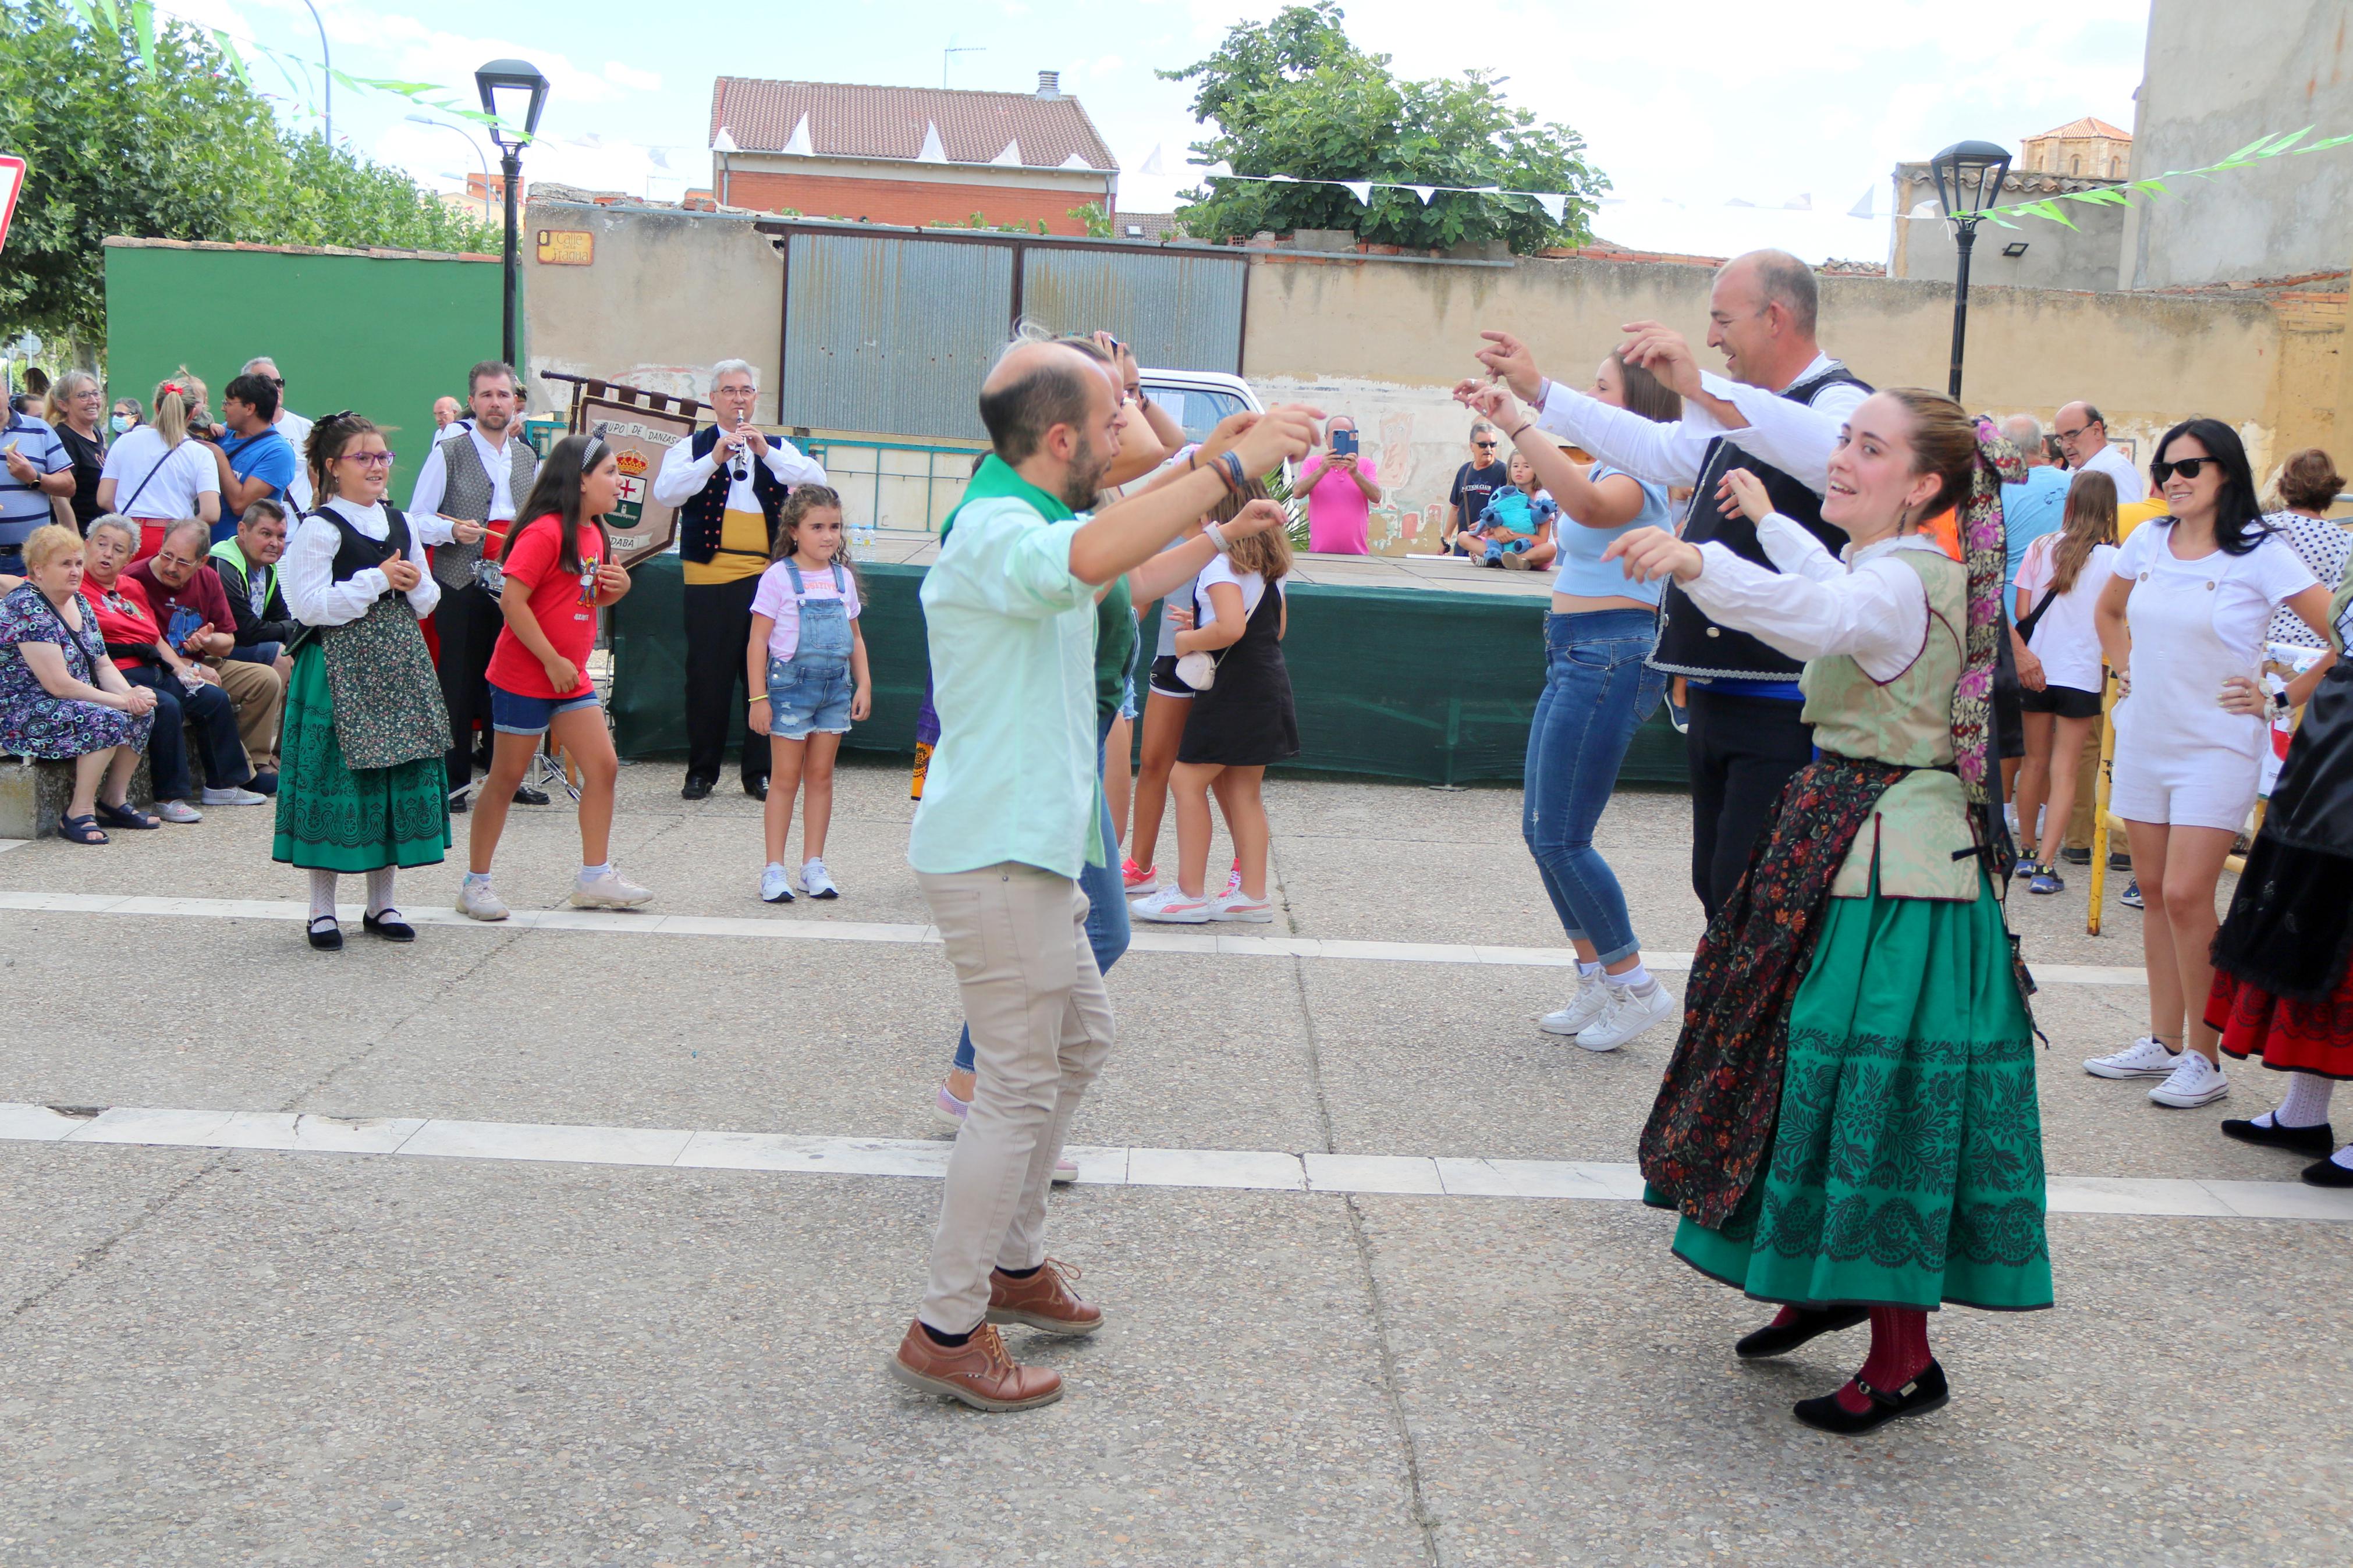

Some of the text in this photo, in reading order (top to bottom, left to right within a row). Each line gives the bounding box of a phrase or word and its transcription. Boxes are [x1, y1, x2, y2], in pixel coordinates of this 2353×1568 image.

[557, 232, 583, 246] Calle
[552, 248, 588, 261] Fragua
[606, 422, 676, 444] UPO DE DANZAS
[611, 537, 634, 548] DABA
